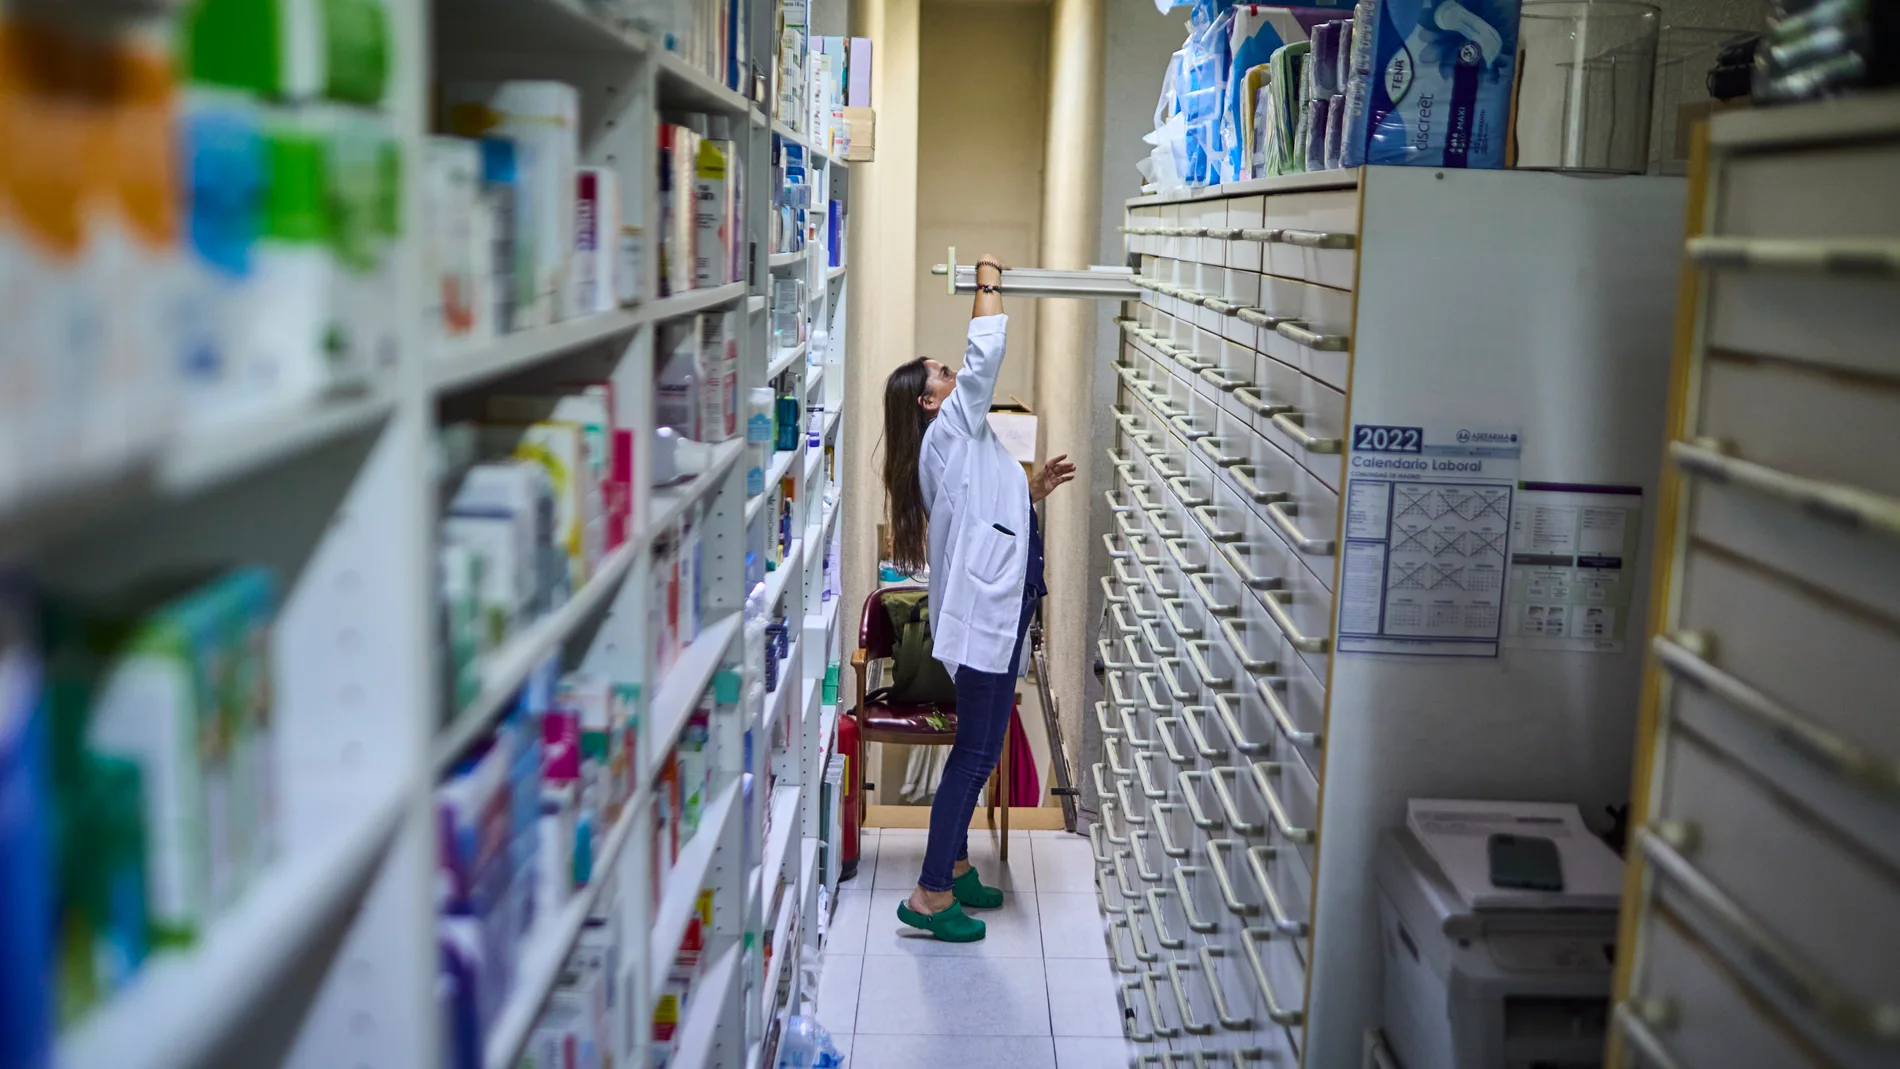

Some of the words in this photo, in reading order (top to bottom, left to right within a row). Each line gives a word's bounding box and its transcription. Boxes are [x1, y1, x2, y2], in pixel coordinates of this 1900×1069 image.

[1391, 59, 1405, 92] TENA
[1411, 93, 1434, 151] discreet
[1457, 106, 1466, 130] MAXI
[1357, 428, 1419, 451] 2022
[1351, 456, 1428, 470] Calendario
[1432, 458, 1482, 472] Laboral
